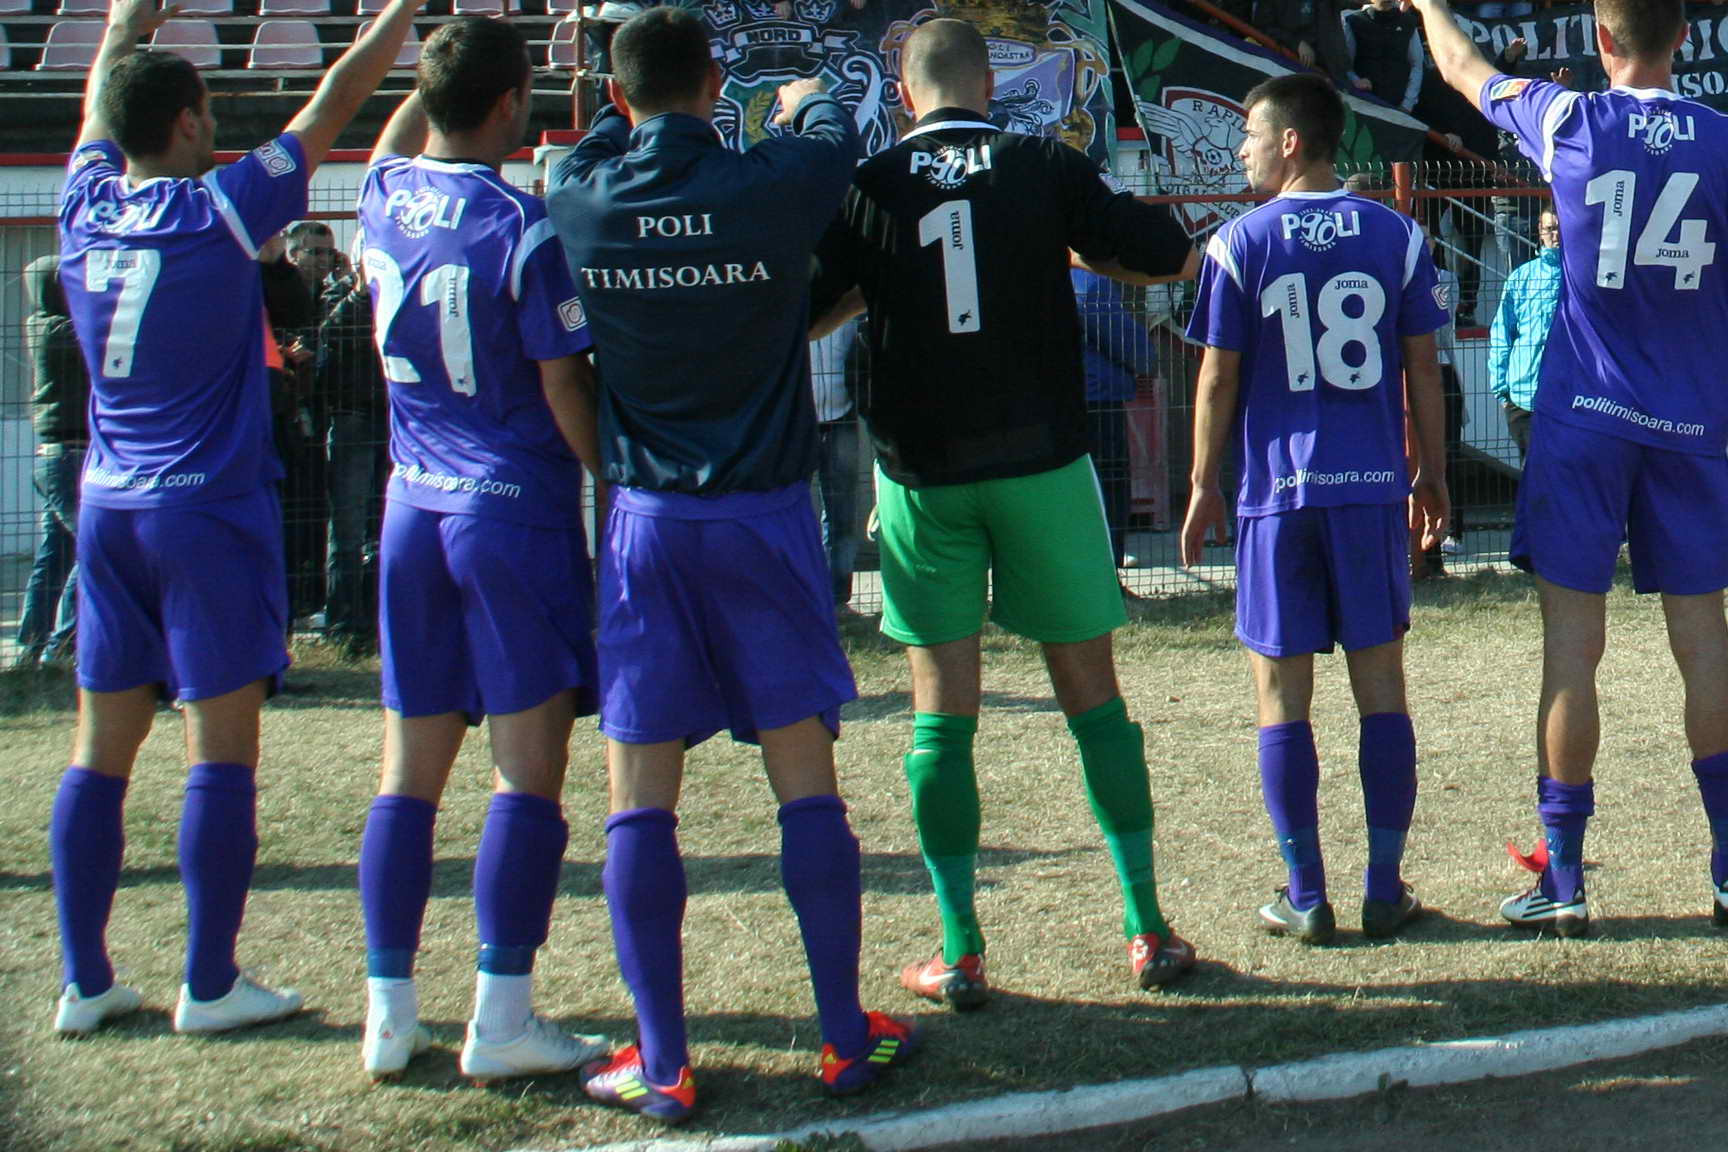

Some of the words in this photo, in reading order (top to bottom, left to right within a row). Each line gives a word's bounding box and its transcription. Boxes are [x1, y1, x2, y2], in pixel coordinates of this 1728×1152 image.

[750, 28, 801, 43] NORD
[1612, 180, 1625, 217] joma
[637, 213, 714, 239] POLI
[1585, 169, 1717, 290] 14
[918, 199, 981, 334] 1
[1655, 247, 1690, 259] joma
[580, 260, 772, 289] TIMISOARA
[1334, 279, 1369, 290] joma
[86, 248, 161, 378] 7
[361, 247, 477, 397] 21
[1260, 271, 1387, 392] 18
[1571, 394, 1706, 437] politimisoara.com
